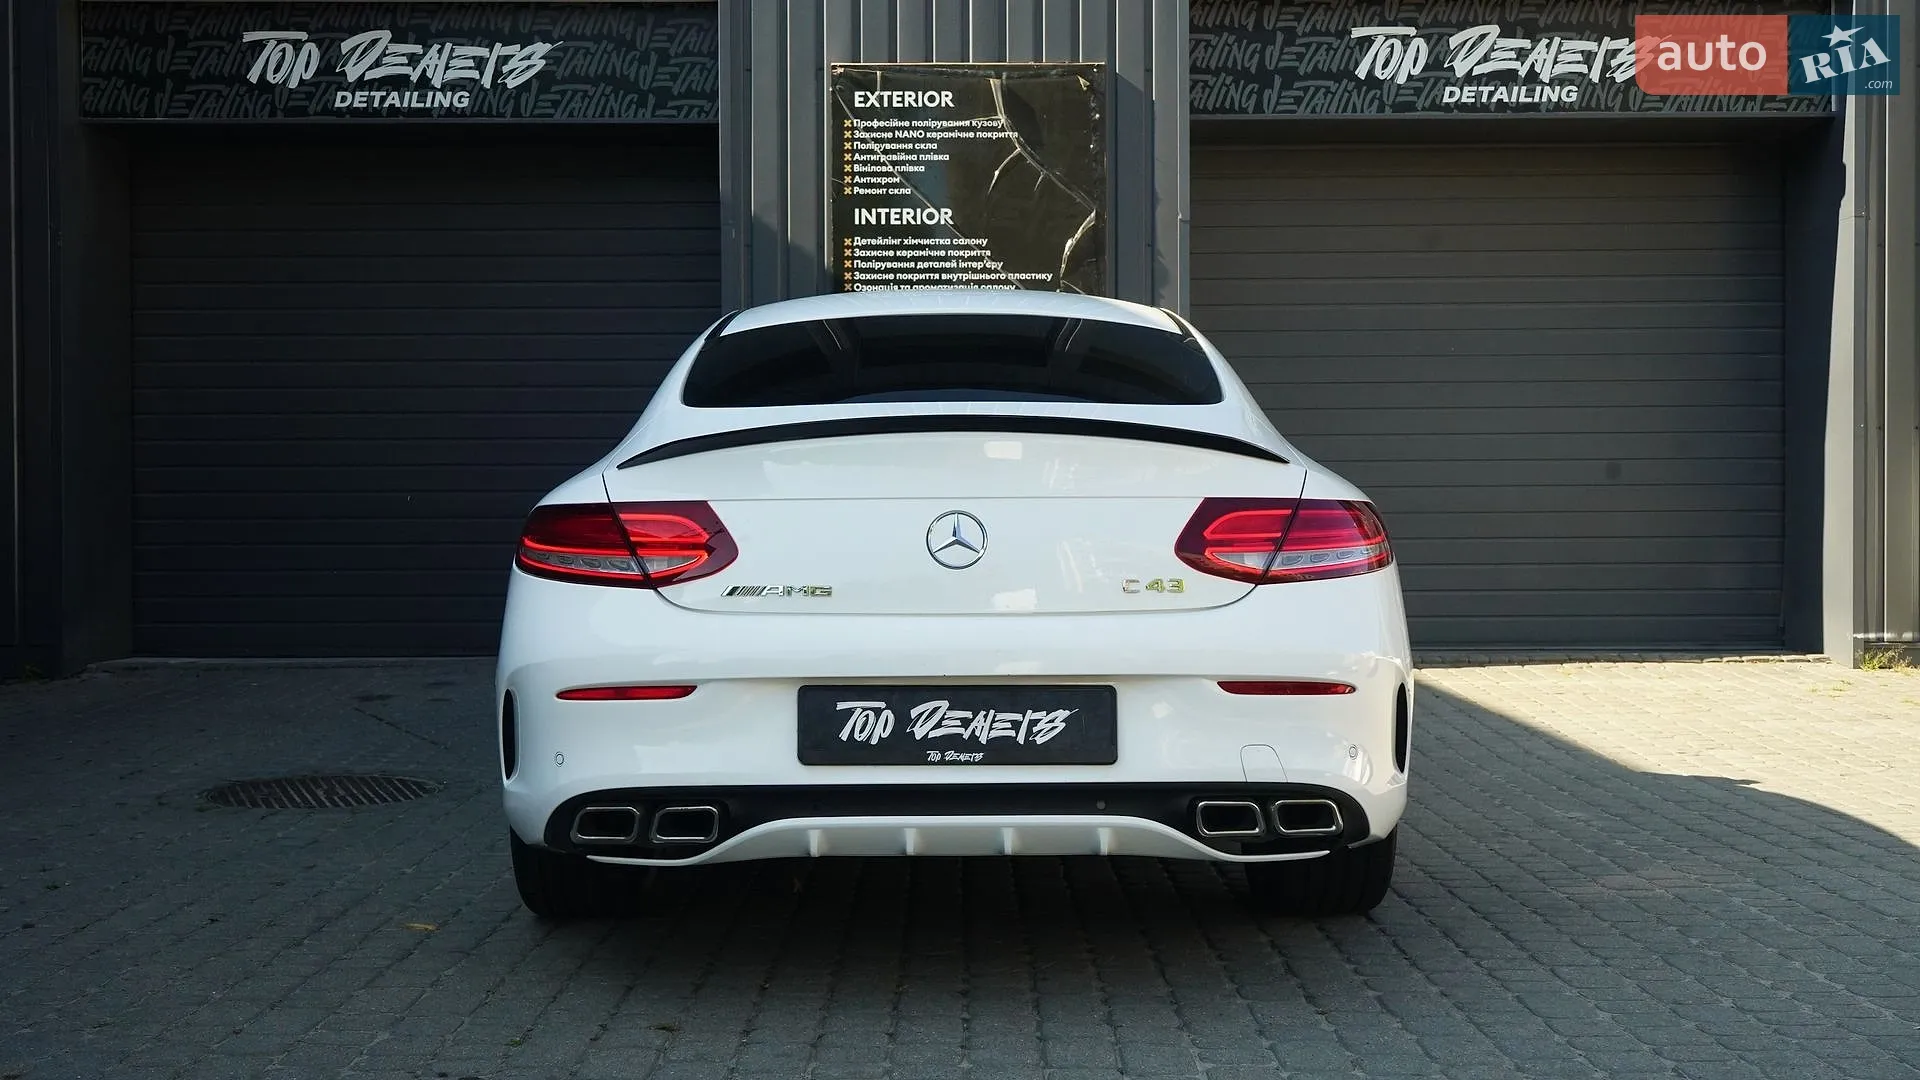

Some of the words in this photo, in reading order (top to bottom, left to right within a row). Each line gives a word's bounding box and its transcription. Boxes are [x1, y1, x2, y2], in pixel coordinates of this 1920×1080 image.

[1442, 86, 1579, 102] DETAILING
[334, 91, 472, 108] DETAILING
[854, 91, 955, 108] EXTERIOR
[853, 119, 910, 128] Професійне
[911, 119, 970, 128] полірування
[971, 120, 1002, 128] кузову
[853, 130, 893, 139] Захисне
[895, 130, 925, 139] NANO
[926, 130, 975, 140] керамічне
[976, 132, 1018, 140] покриття
[853, 142, 913, 152] Полірування
[853, 153, 918, 162] Антигравійна
[919, 153, 950, 161] плівка
[853, 164, 893, 172] Вінілова
[894, 164, 925, 172] плівка
[853, 176, 900, 185] Антихром
[853, 187, 887, 195] Ремонт
[854, 208, 954, 225] INTERIOR
[853, 236, 902, 246] Детейлінг
[903, 236, 951, 246] хімчистка
[952, 238, 988, 247] салону
[853, 249, 894, 257] Захисне
[896, 248, 946, 258] керамічне
[947, 250, 991, 258] покриття
[853, 260, 915, 270] Полірування
[916, 260, 957, 270] деталей
[853, 272, 894, 280] Захисне
[896, 273, 939, 282] покриття
[941, 272, 1006, 281] внутрішнього
[1007, 273, 1053, 282] пластику
[1122, 578, 1141, 594] C
[1145, 578, 1185, 593] 43
